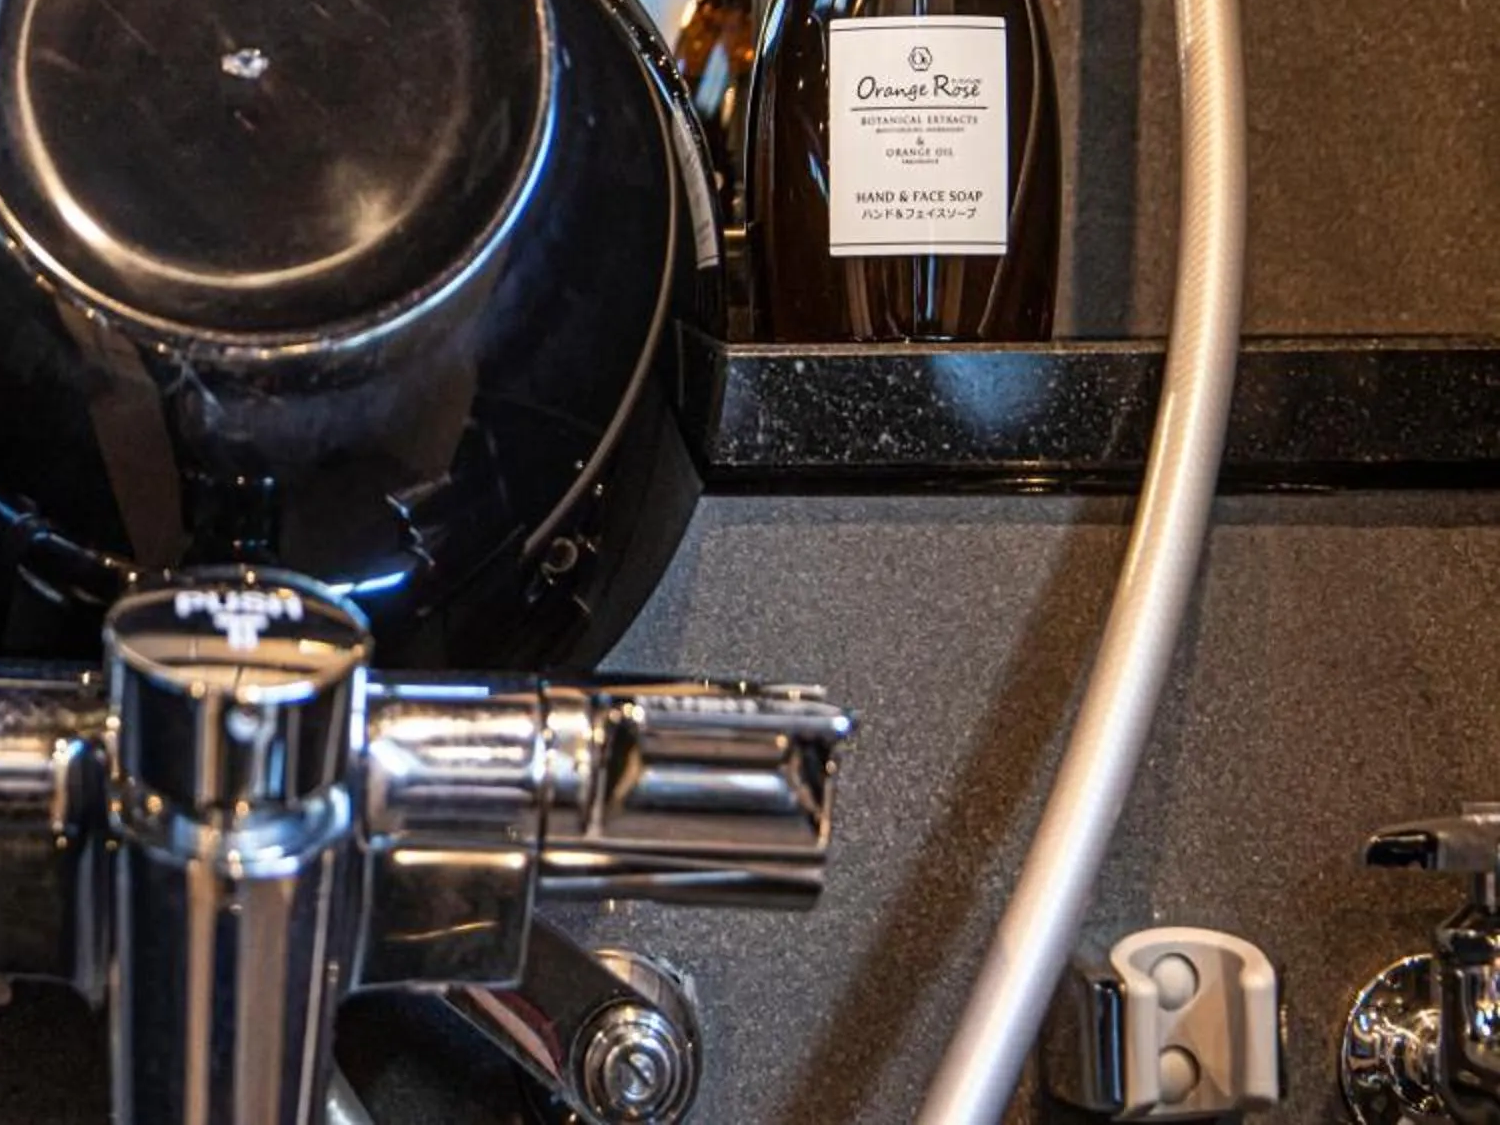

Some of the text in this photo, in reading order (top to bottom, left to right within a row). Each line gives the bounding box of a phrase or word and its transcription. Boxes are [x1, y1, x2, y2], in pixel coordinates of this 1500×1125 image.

[856, 76, 928, 101] Orange
[856, 190, 983, 204] HAND & FACE SOAP
